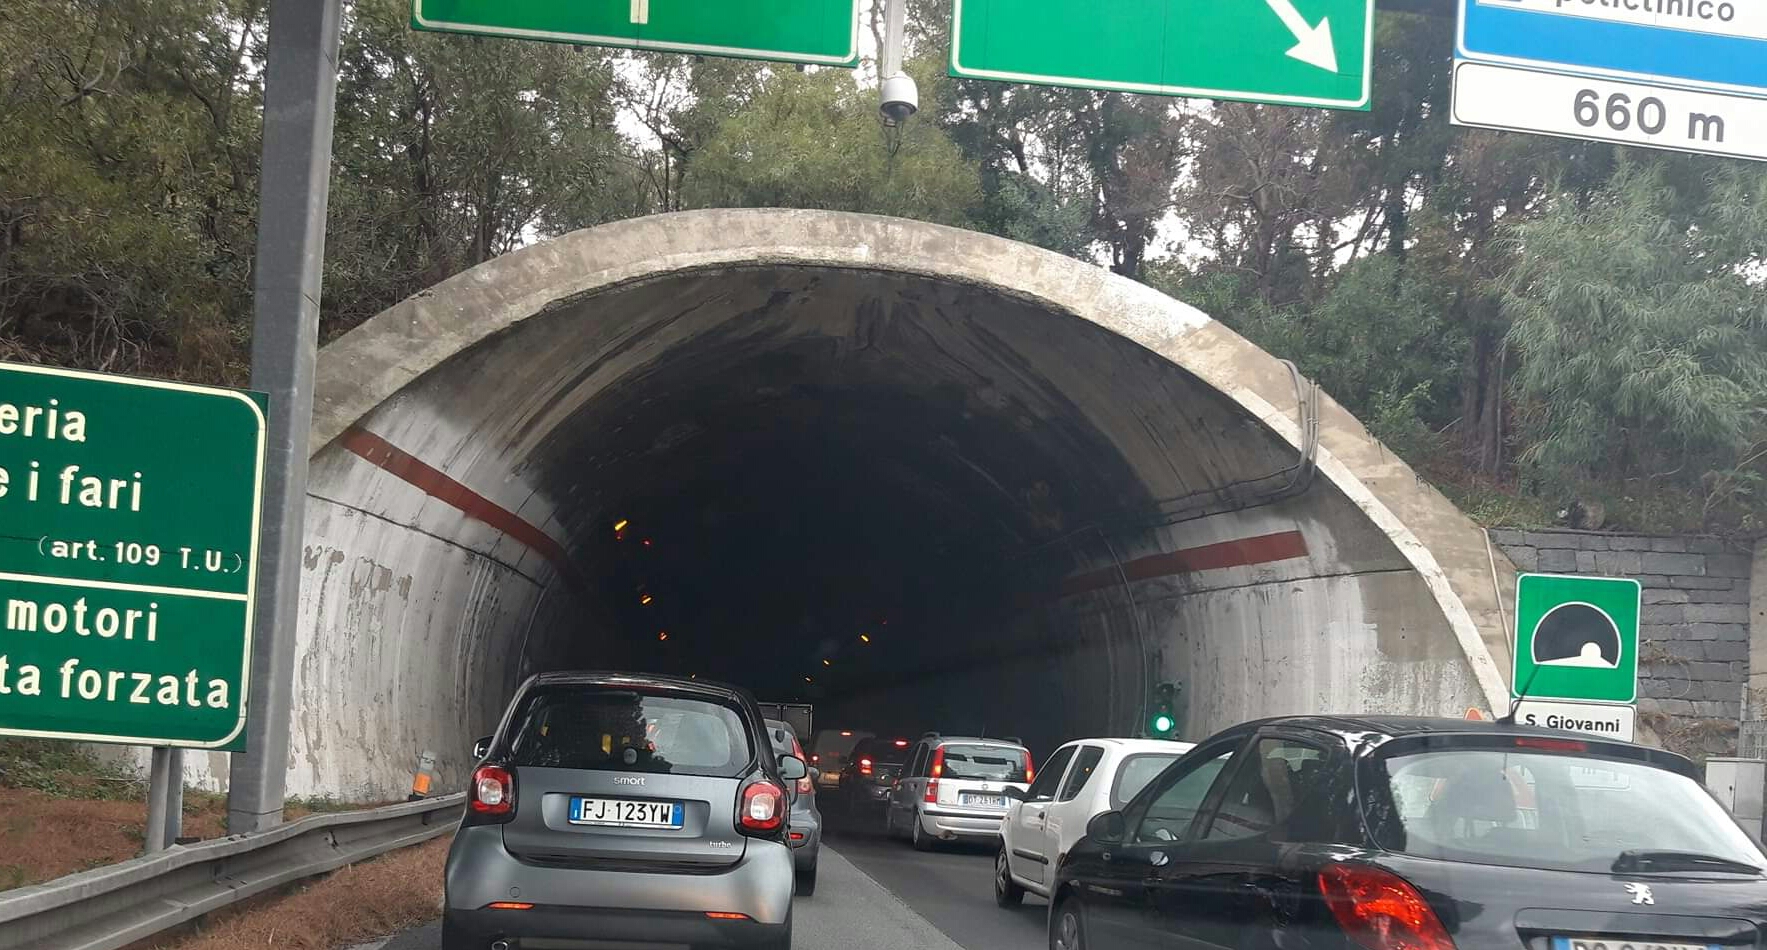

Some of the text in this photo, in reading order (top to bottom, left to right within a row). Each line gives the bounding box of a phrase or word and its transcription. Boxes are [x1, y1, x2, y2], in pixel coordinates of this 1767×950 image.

[1573, 89, 1725, 142] 660 m
[0, 399, 87, 442] eria
[29, 461, 40, 501] i
[60, 465, 143, 512] fari
[38, 535, 242, 574] (art. 109 T.U.)
[7, 598, 158, 642] motori
[61, 658, 229, 709] forzata
[1547, 715, 1620, 732] Giovanni
